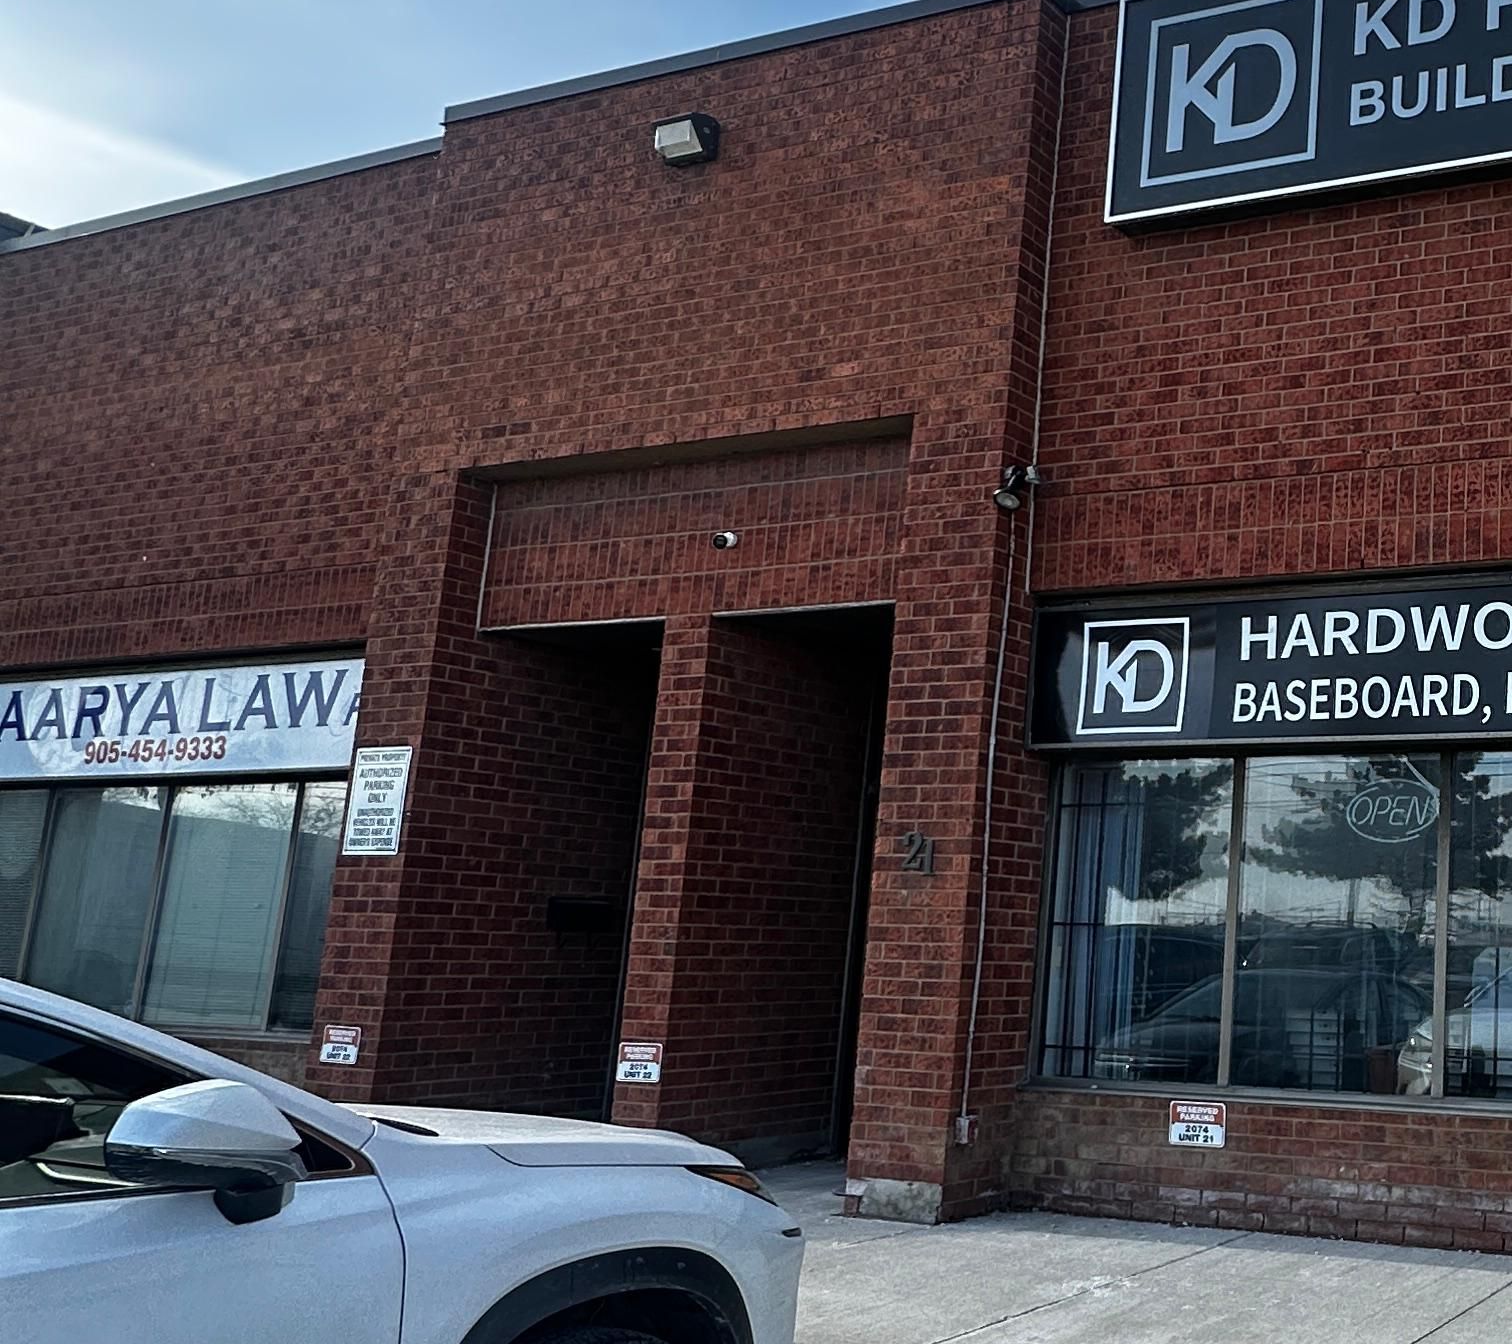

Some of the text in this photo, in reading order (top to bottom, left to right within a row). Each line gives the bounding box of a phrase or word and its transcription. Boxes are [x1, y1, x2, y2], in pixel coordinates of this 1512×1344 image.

[1165, 28, 1297, 153] KD
[1092, 639, 1175, 715] KD
[0, 680, 181, 743] AARYA
[198, 669, 349, 733] LAW
[1232, 672, 1491, 724] BASEBOARD,
[84, 735, 227, 765] 905-454-9333
[1352, 795, 1431, 826] OPEN
[903, 831, 935, 876] 21
[1177, 1105, 1219, 1115] RESERVED
[1180, 1113, 1215, 1122] PARKING
[1178, 1133, 1214, 1143] UNIT 21
[1185, 1124, 1209, 1133] 2074
